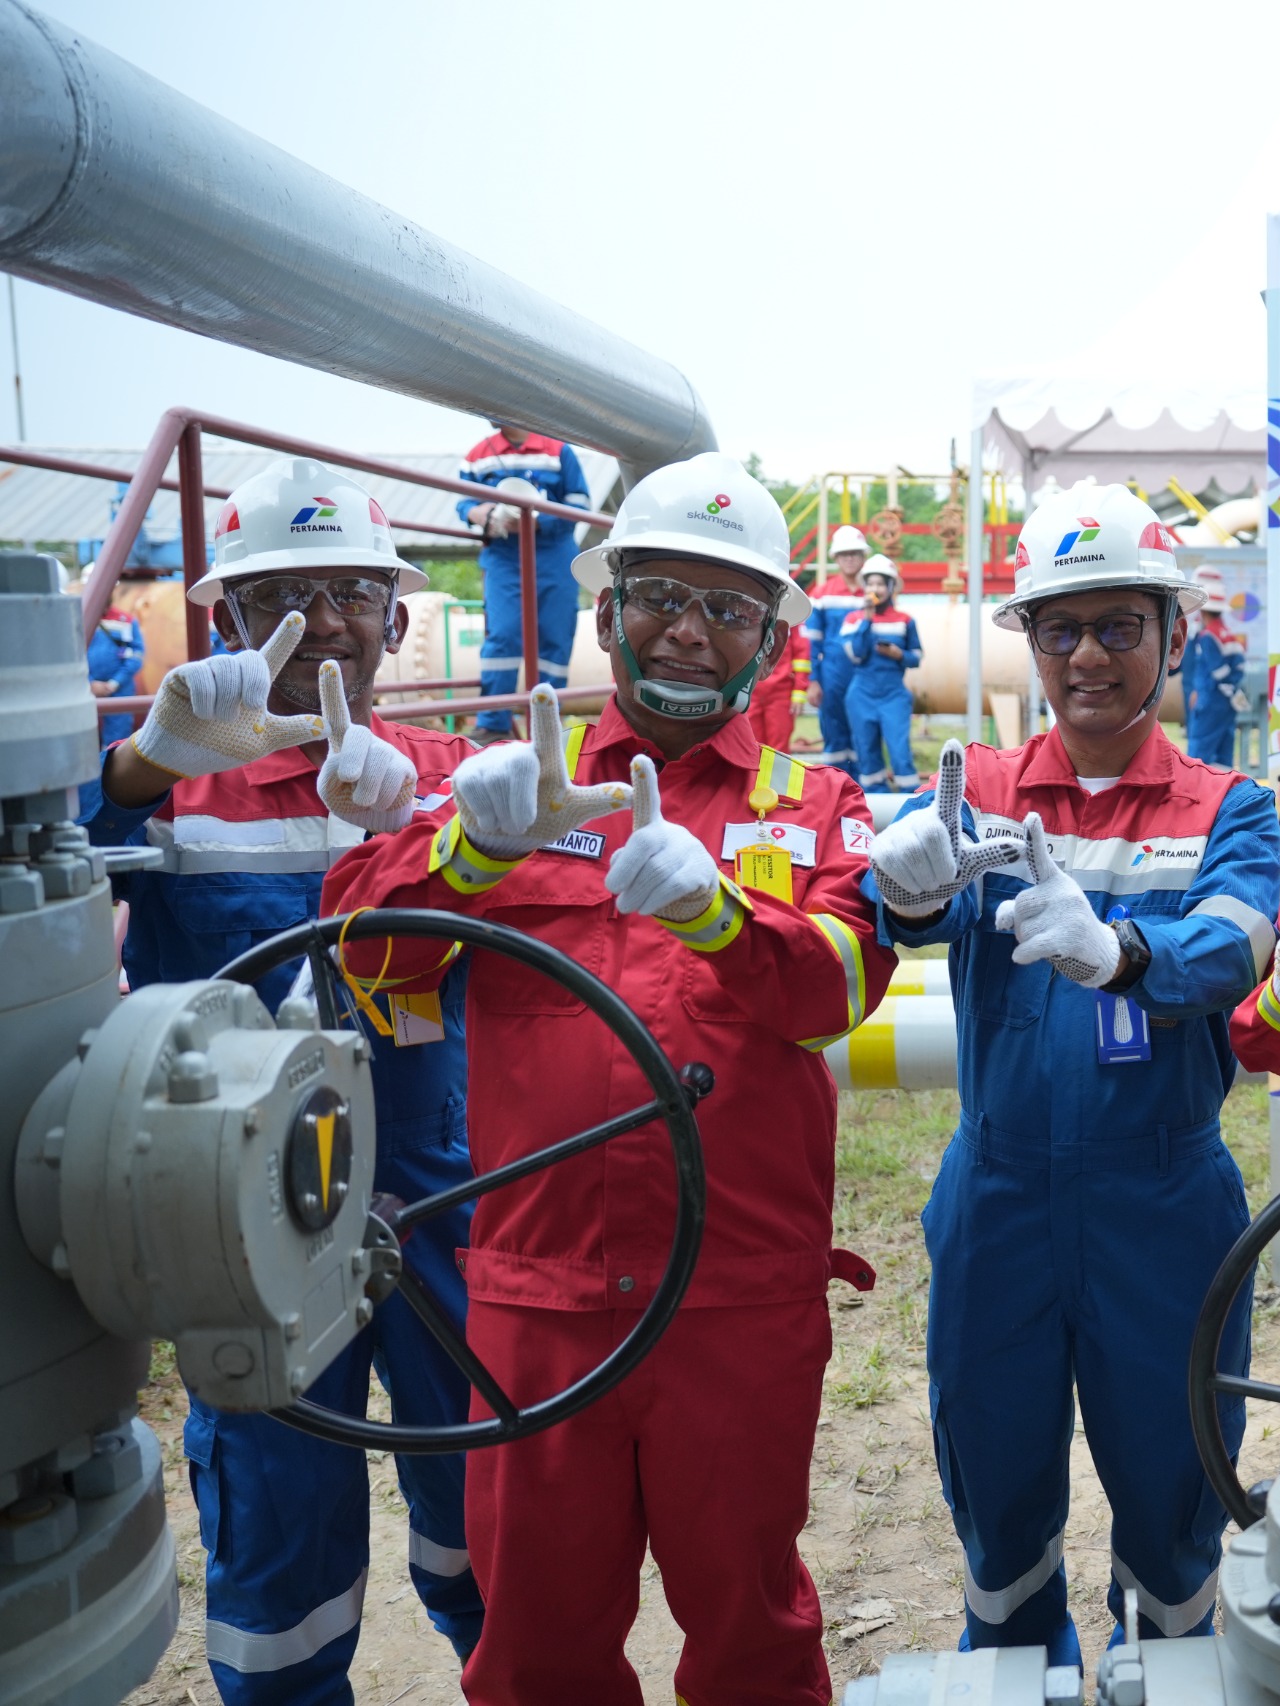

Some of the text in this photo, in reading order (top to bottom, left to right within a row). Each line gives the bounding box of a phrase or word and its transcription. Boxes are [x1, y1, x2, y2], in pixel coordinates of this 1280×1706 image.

[290, 525, 342, 533] PERTAMINA
[687, 510, 744, 532] skkmigas
[1054, 553, 1105, 567] PERTAMINA
[557, 833, 598, 853] WANTO
